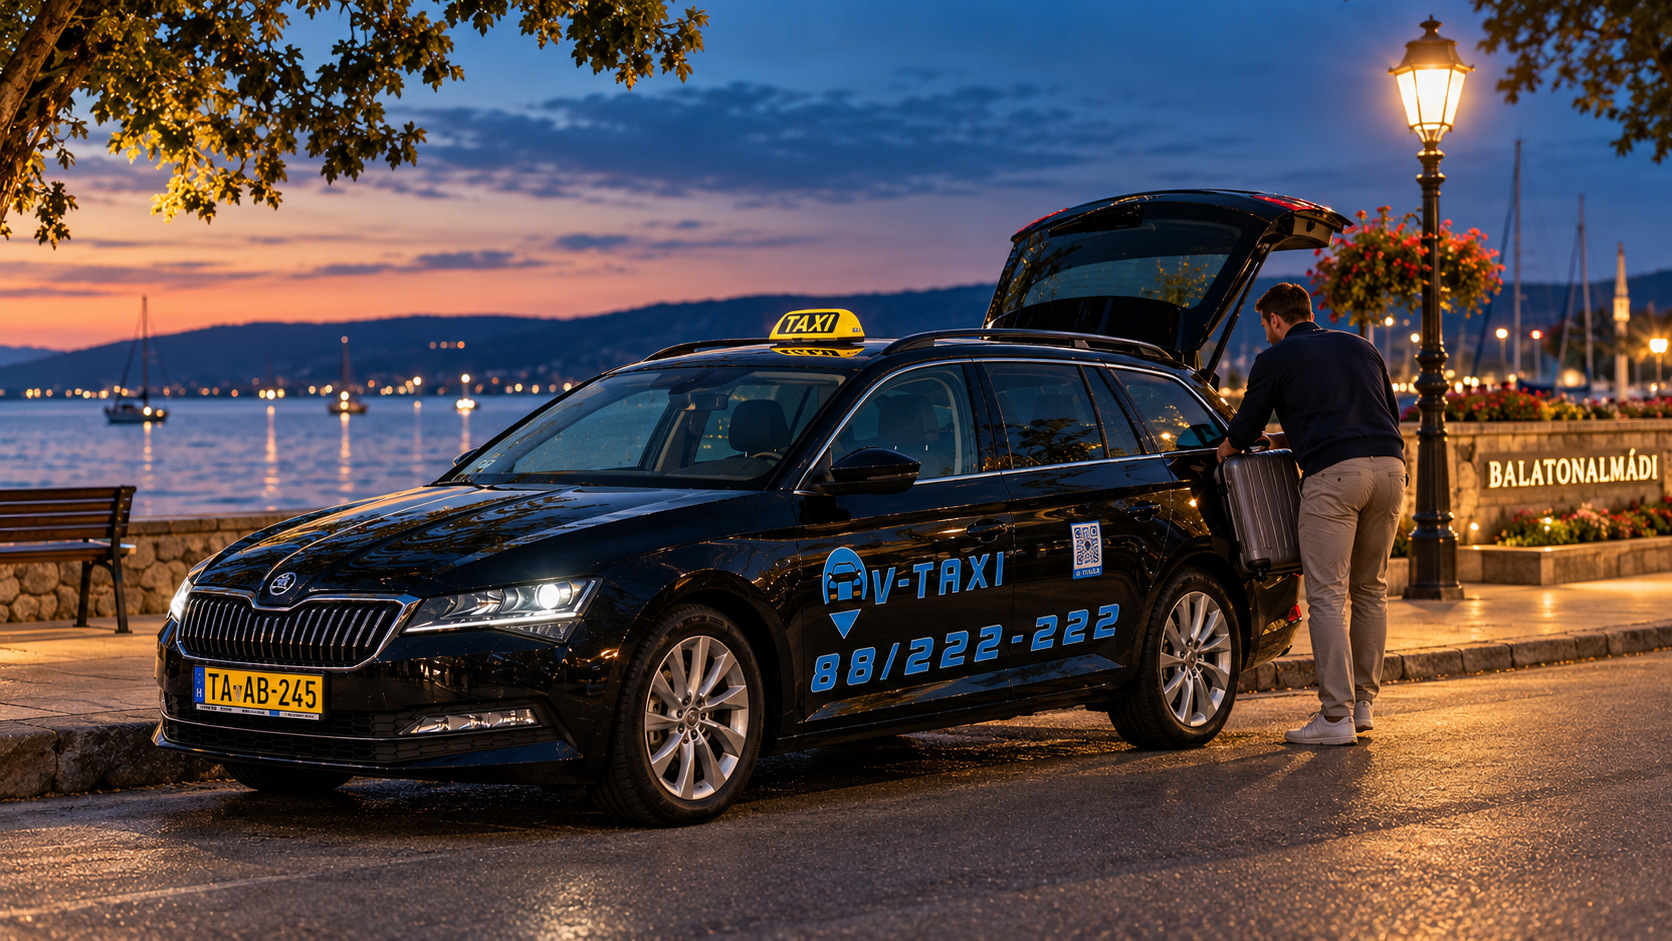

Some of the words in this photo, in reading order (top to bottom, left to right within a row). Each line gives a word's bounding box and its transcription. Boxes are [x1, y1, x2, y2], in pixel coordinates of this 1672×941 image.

[785, 314, 836, 332] TAXI
[1489, 448, 1658, 488] BALATONALMÁDI
[872, 551, 1005, 605] V-TAXI
[811, 603, 1120, 693] 88/222-222
[196, 688, 202, 698] H
